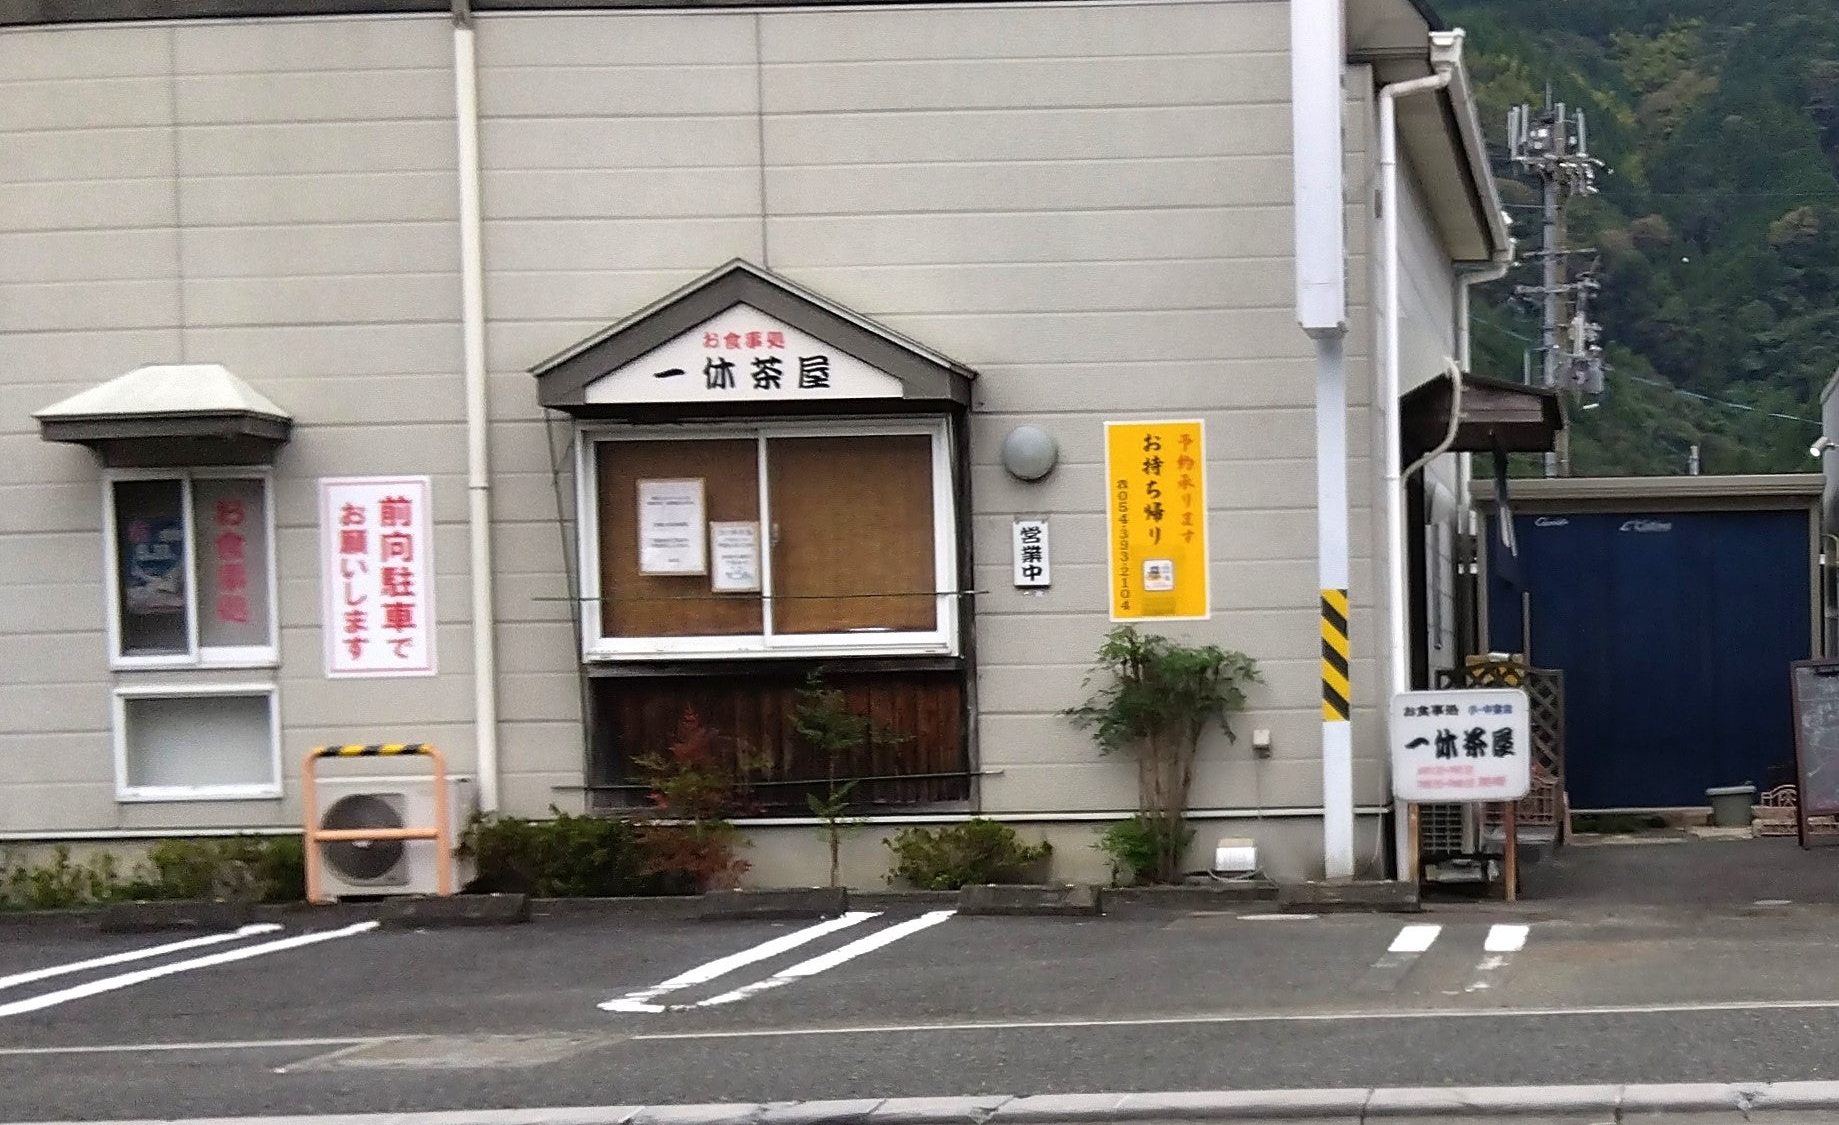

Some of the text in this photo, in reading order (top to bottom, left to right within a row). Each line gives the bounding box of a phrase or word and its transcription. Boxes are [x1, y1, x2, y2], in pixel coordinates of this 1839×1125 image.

[703, 331, 785, 350] お食事処
[653, 355, 831, 390] 一休茶屋
[1142, 433, 1164, 545] お持ち帰り
[339, 500, 369, 660] お願いします
[378, 495, 417, 659] 前向駐車で
[1020, 526, 1042, 581] 営業中
[1404, 727, 1515, 760] 一休茶屋
